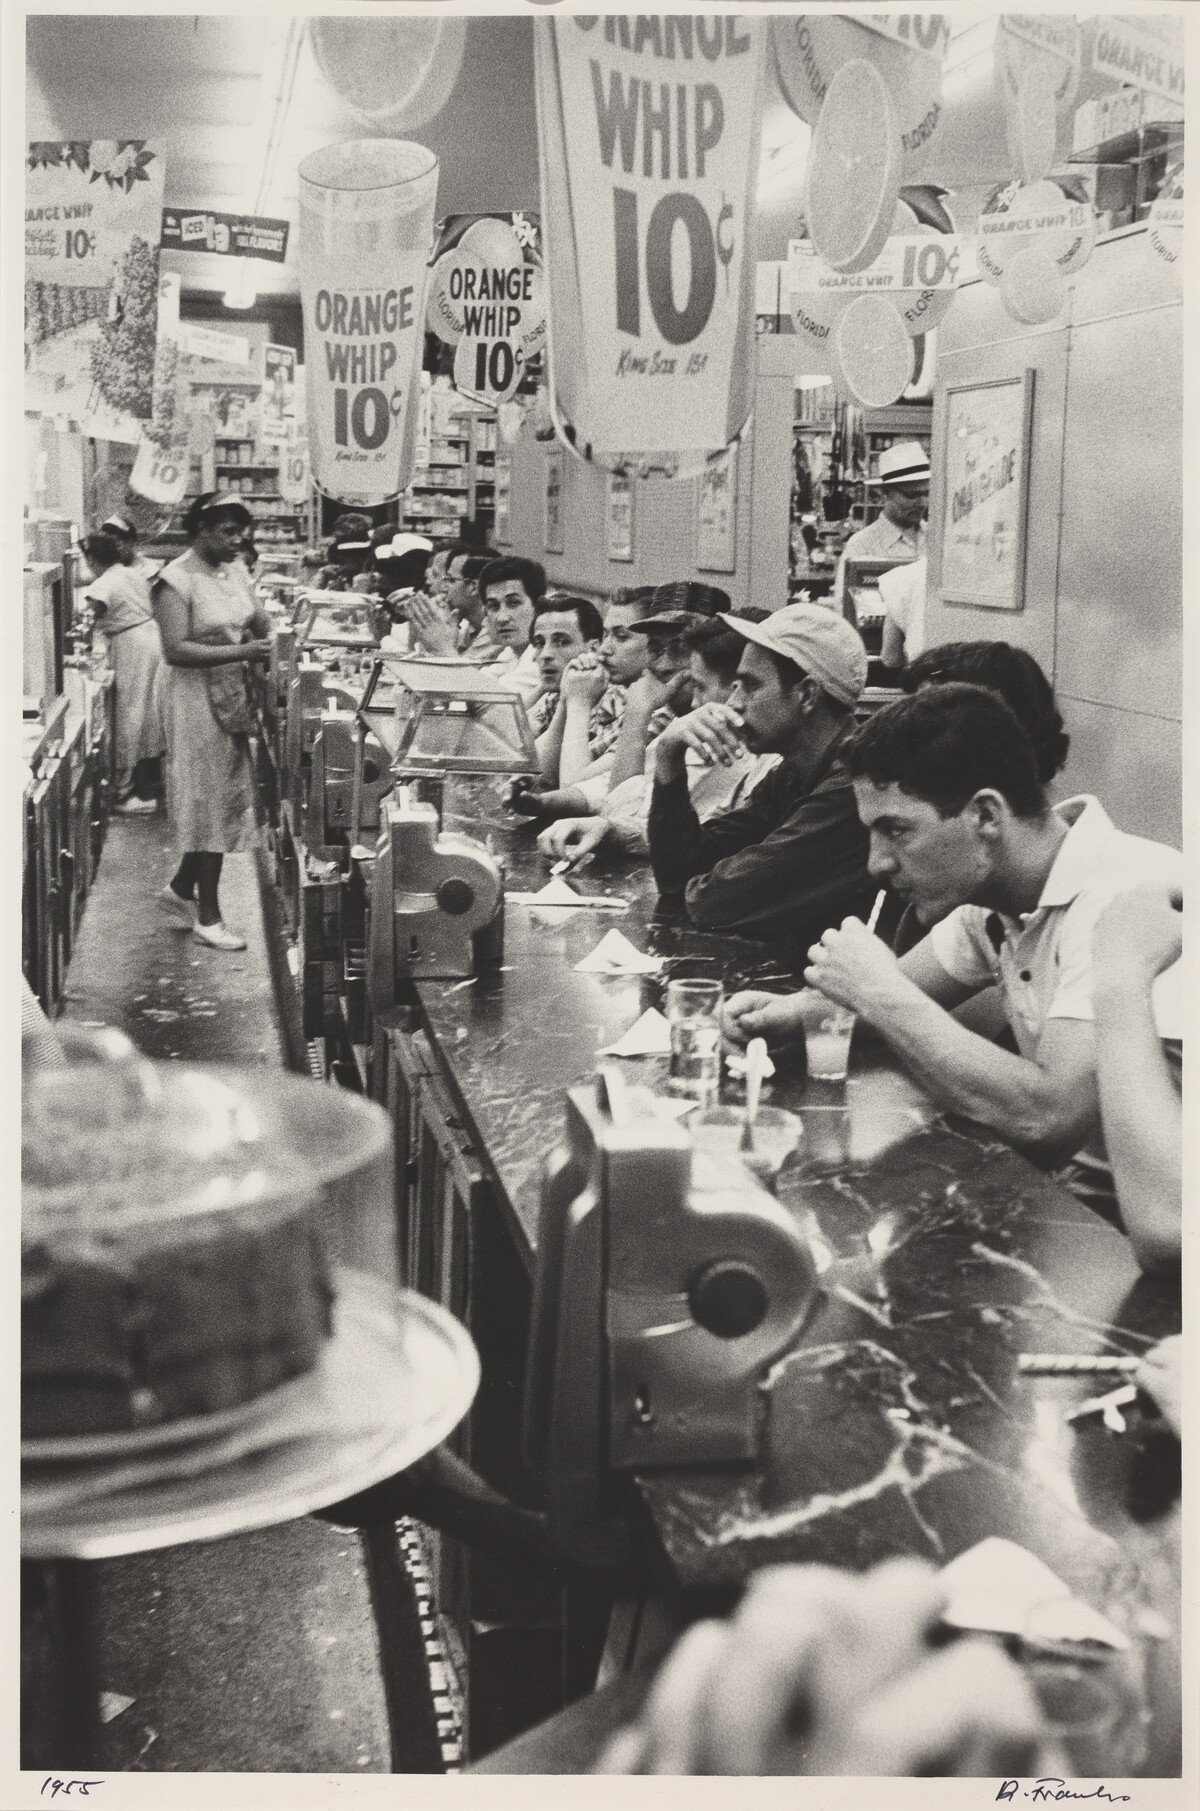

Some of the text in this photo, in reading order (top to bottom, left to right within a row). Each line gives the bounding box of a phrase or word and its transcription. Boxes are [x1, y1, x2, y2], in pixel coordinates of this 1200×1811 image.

[589, 58, 724, 180] WHIP
[65, 229, 96, 260] 10¢
[982, 219, 1032, 235] ORANGE
[450, 267, 534, 301] ORANGE
[612, 185, 735, 346] 10¢
[818, 275, 895, 288] ORANGE WHIP
[903, 243, 960, 288] 10¢
[315, 285, 414, 336] ORANGE
[464, 305, 521, 338] WHIP
[325, 340, 397, 384] WHIP
[475, 341, 524, 392] 10¢
[334, 385, 402, 451] 10¢
[41, 1777, 105, 1798] 1955
